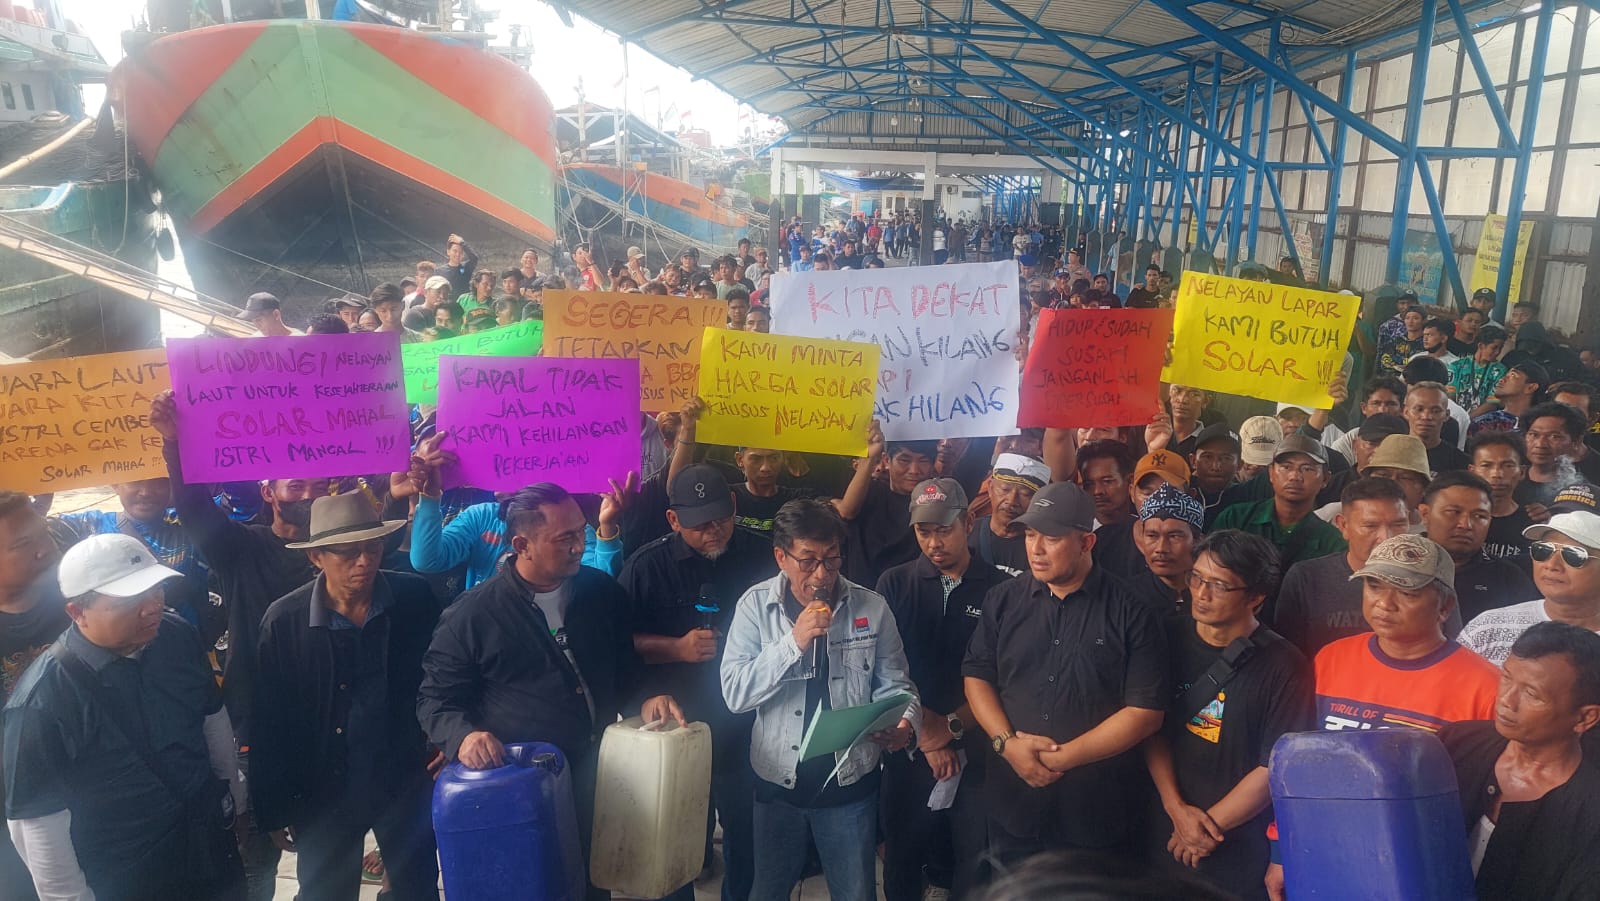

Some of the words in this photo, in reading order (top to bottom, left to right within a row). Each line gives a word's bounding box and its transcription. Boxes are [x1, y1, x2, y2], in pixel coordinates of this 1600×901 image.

[562, 295, 693, 330] SEGERA
[808, 281, 902, 323] KITA
[911, 280, 1008, 319] DEKAT
[1186, 276, 1273, 305] NELAYAN
[1282, 291, 1342, 319] LAPAR
[1203, 307, 1260, 341] KAMI
[1270, 319, 1340, 350] BUTUH
[336, 350, 392, 371] NELAYAN
[720, 335, 777, 363] KAMI
[792, 344, 864, 368] MINTA
[915, 327, 1011, 367] KILANG
[1202, 340, 1308, 381] SOLAR
[77, 362, 168, 391] LAUT
[453, 361, 540, 395] KAPAL
[547, 367, 623, 394] TIDAK
[715, 368, 799, 398] HARGA
[809, 377, 872, 398] SOLAR
[72, 391, 151, 412] KITA
[187, 384, 236, 406] LAUT
[243, 382, 299, 400] UNTUK
[487, 397, 576, 418] JALAN
[908, 381, 1006, 422] HILANG
[215, 406, 325, 440] SOLAR
[326, 404, 395, 432] MAHAL
[451, 423, 510, 447] KAMI
[520, 416, 628, 447] KEHILANGAN
[706, 402, 769, 418] KHUSUS
[775, 405, 856, 435] NELAYAN
[40, 464, 92, 482] SOLAR
[103, 457, 145, 474] MAHAL
[214, 446, 272, 468] ISTRI
